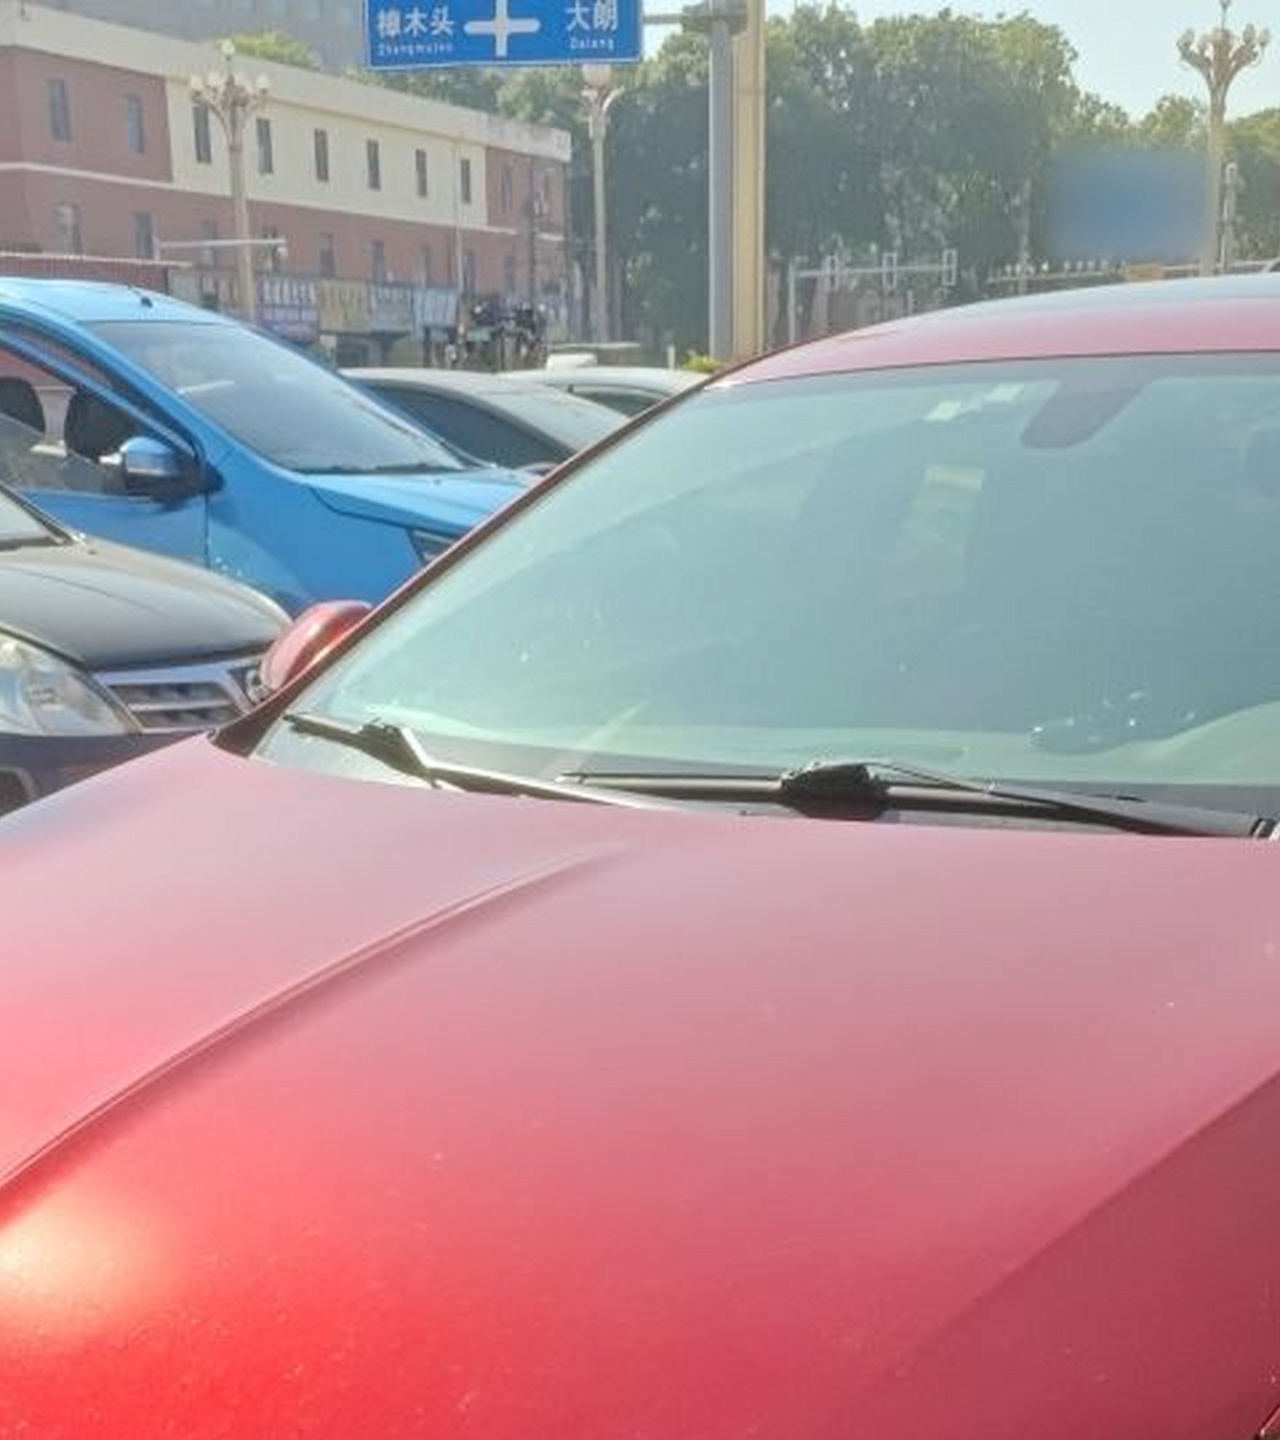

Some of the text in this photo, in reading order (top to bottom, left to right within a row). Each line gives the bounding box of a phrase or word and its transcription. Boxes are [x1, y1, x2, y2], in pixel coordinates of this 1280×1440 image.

[378, 6, 454, 39] 樟木头
[565, 0, 618, 32] 大朗
